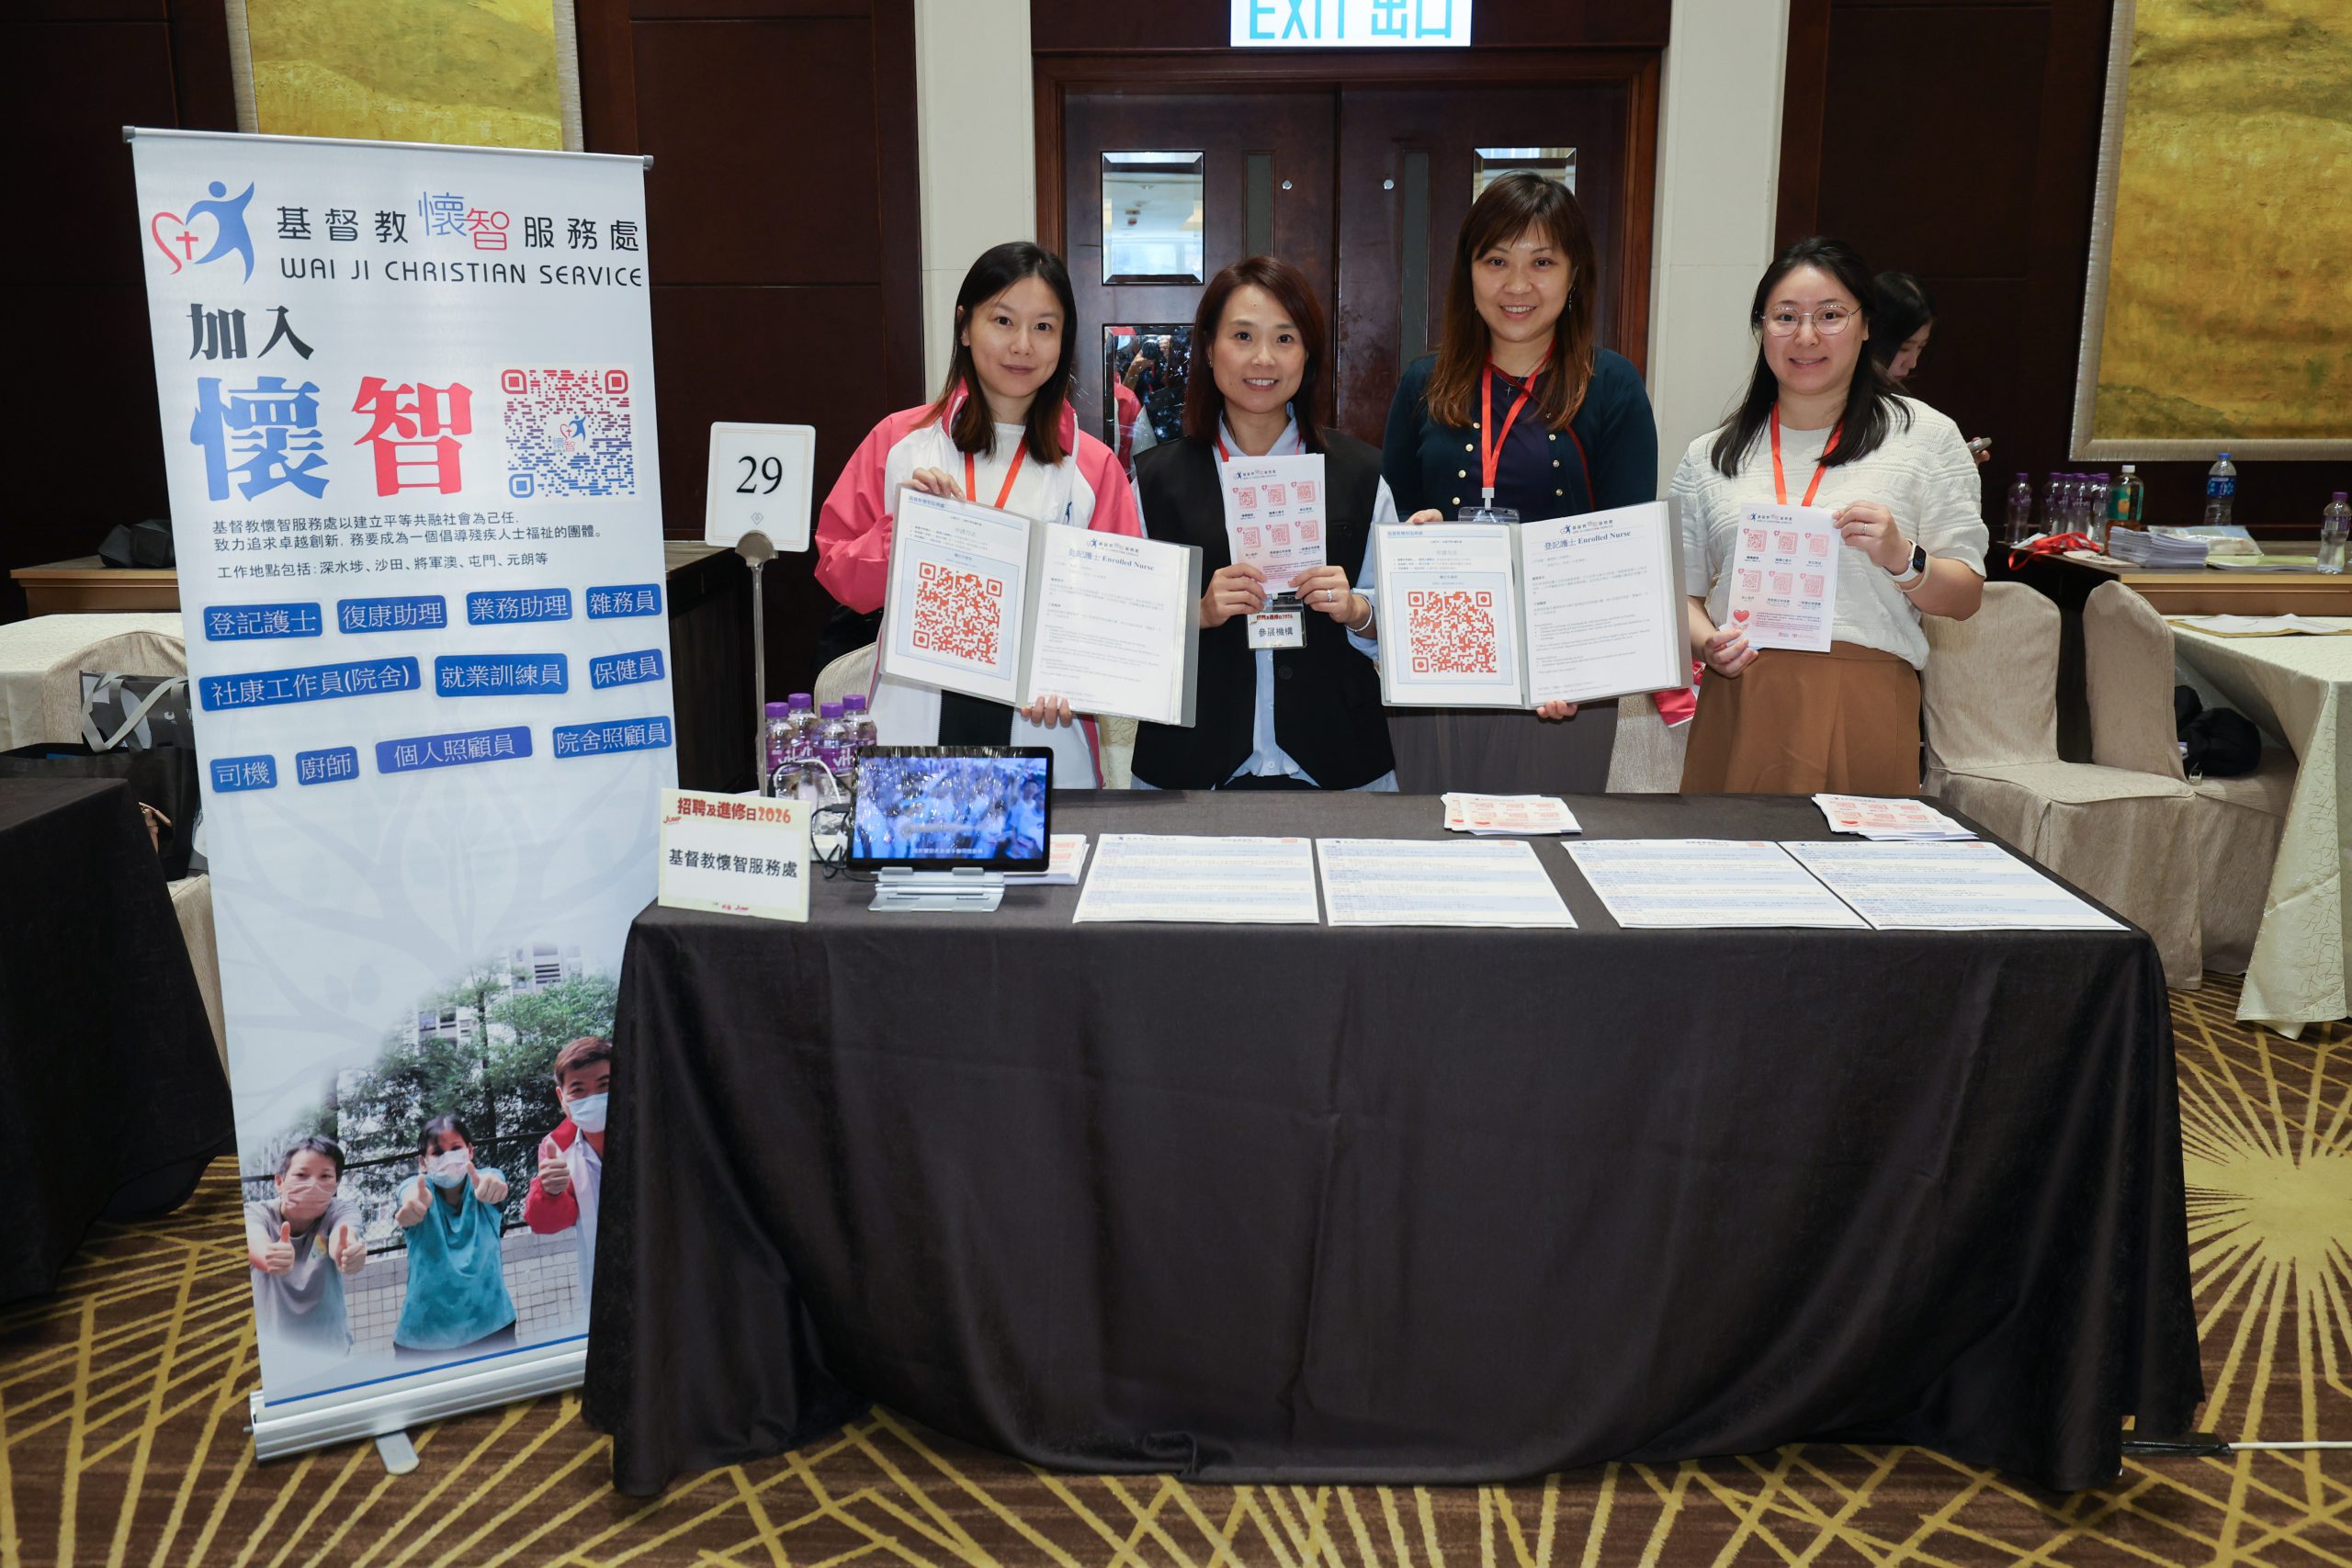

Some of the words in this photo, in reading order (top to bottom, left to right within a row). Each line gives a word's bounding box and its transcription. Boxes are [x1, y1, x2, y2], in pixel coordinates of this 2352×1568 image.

[277, 191, 639, 251] 基督教懷智服務處
[280, 257, 335, 279] WAI
[351, 260, 369, 280] JI
[385, 260, 526, 284] CHRISTIAN
[539, 265, 642, 287] SERVICE
[186, 303, 314, 360] 加入
[189, 375, 473, 502] 懷智
[736, 456, 783, 494] 29
[1577, 533, 1608, 545] Enrolled
[1610, 531, 1631, 540] Nurse
[1102, 556, 1132, 567] Enrolled
[1134, 561, 1154, 571] Nurse
[342, 602, 444, 629] 復康助理
[470, 594, 569, 621] 業務助理
[589, 590, 656, 615] 雜務員
[209, 608, 317, 637] 登記護士
[440, 664, 562, 689] 就業訓練員
[594, 655, 659, 685] 保健員
[210, 664, 410, 706] 社康工作員(院舍)
[393, 733, 515, 768] 個人照顧員
[556, 722, 667, 754] 院舍照顧員
[216, 761, 270, 787] 司機
[300, 752, 352, 781] 廚師
[677, 797, 791, 824] 招聘及進修日2026
[669, 848, 798, 878] 基督教懷智服務處
